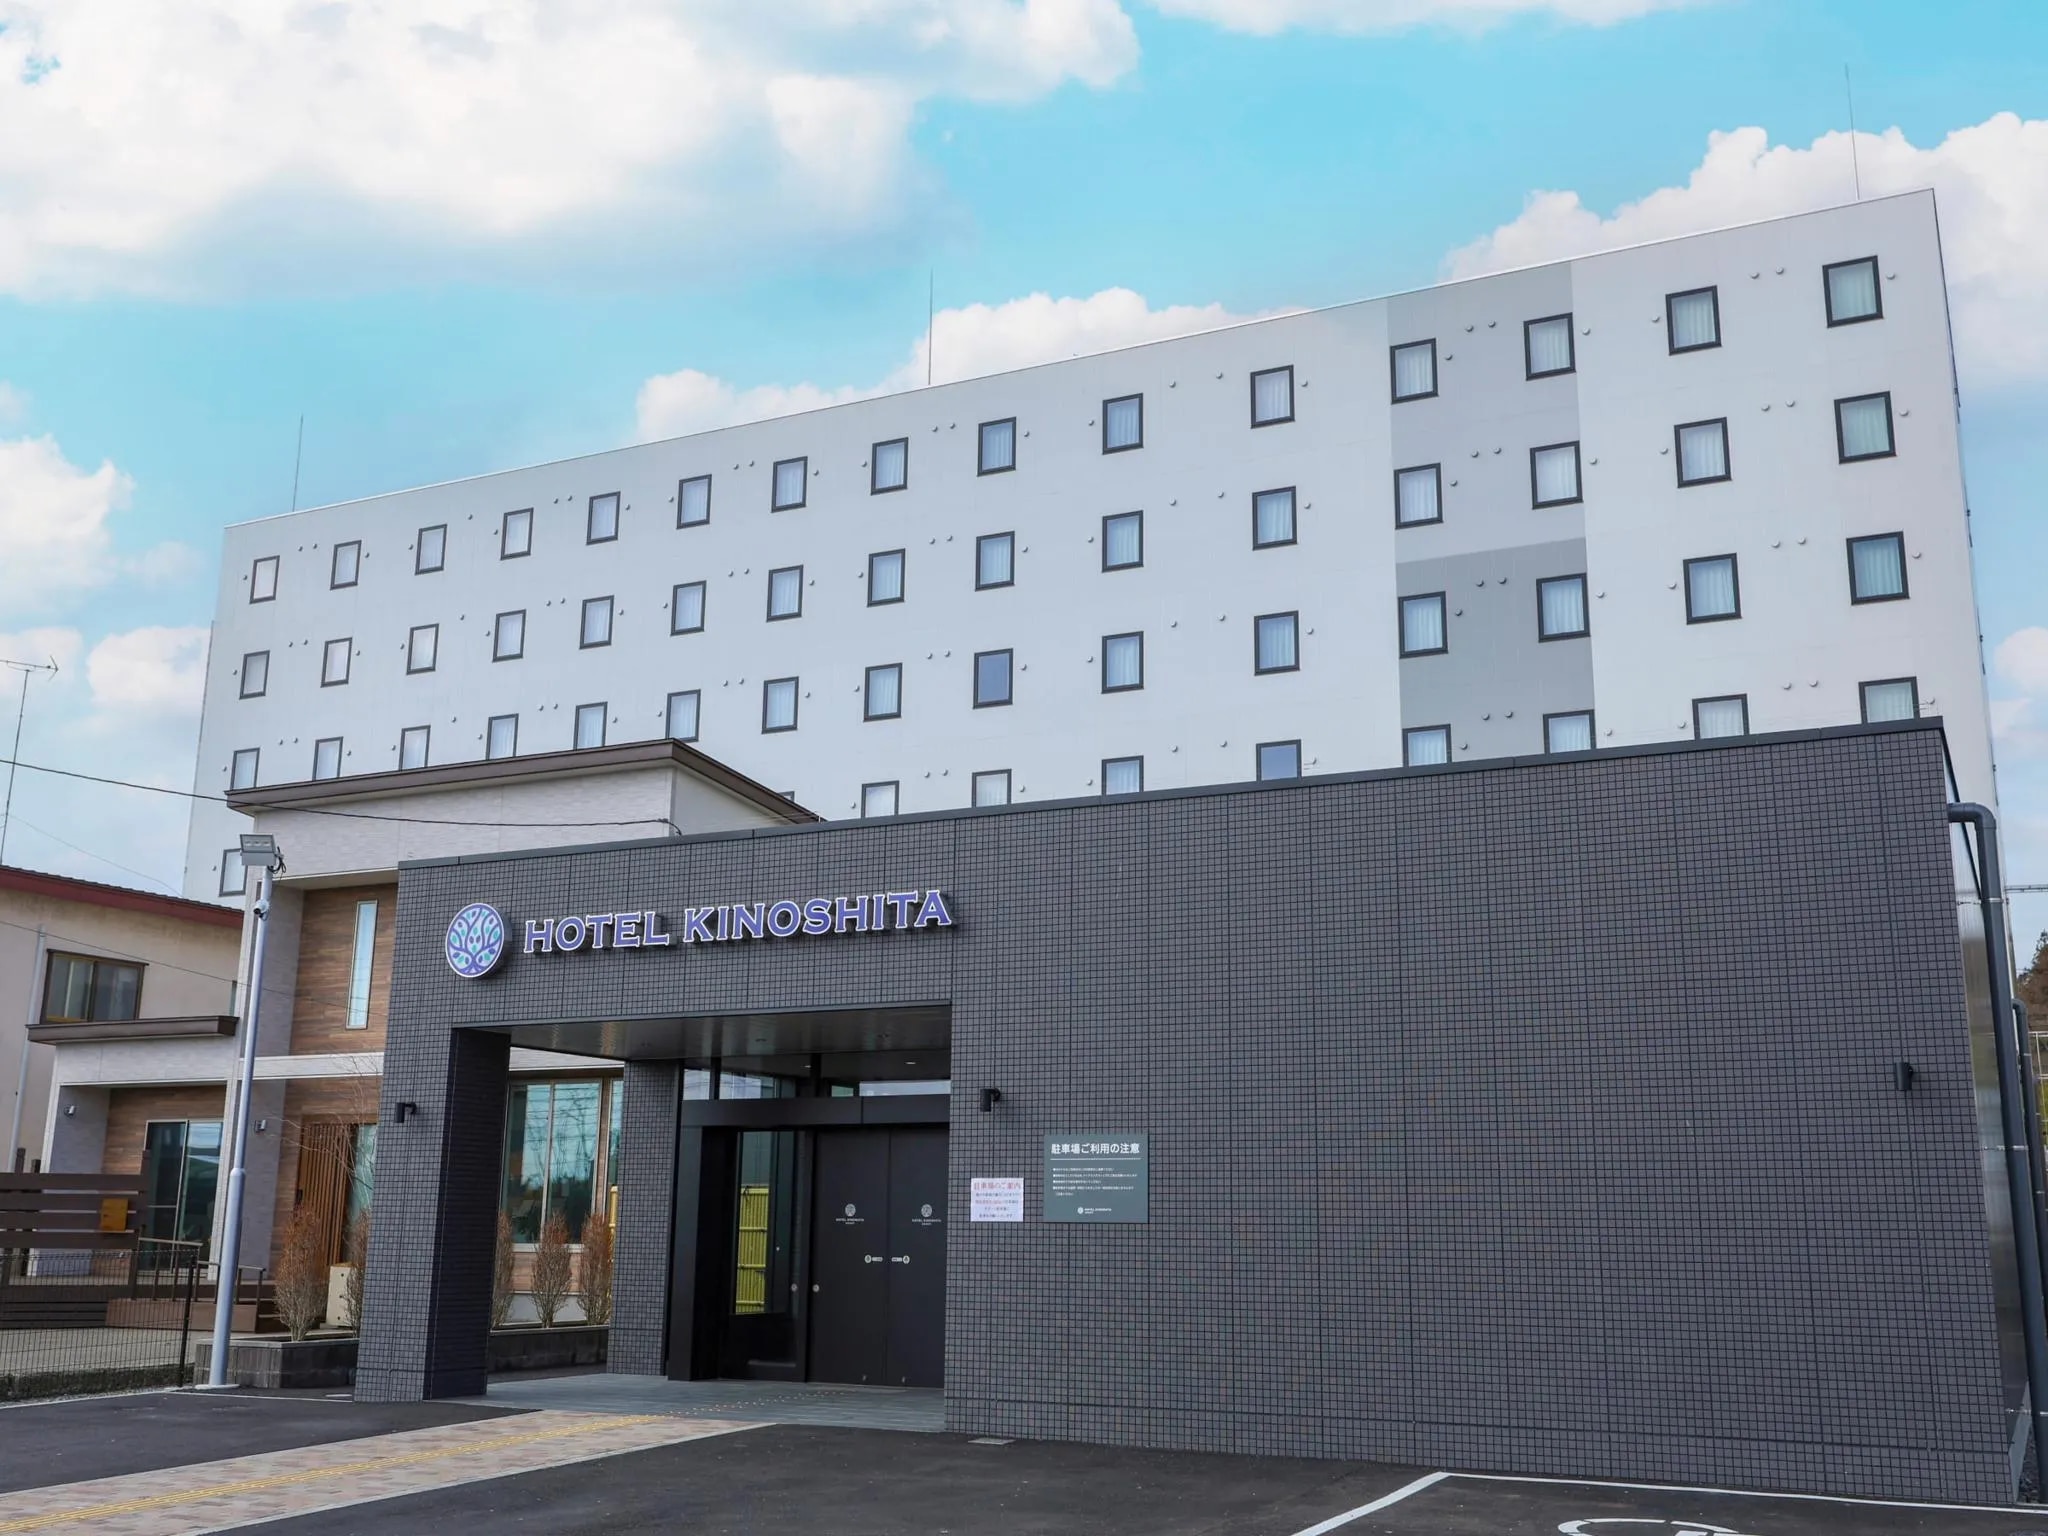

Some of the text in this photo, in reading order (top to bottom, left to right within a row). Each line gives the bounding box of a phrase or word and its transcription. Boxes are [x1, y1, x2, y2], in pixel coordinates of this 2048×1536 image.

[524, 889, 952, 953] HOTEL KINOSHITA
[1051, 1143, 1140, 1155] 駐車場ご利用の注意
